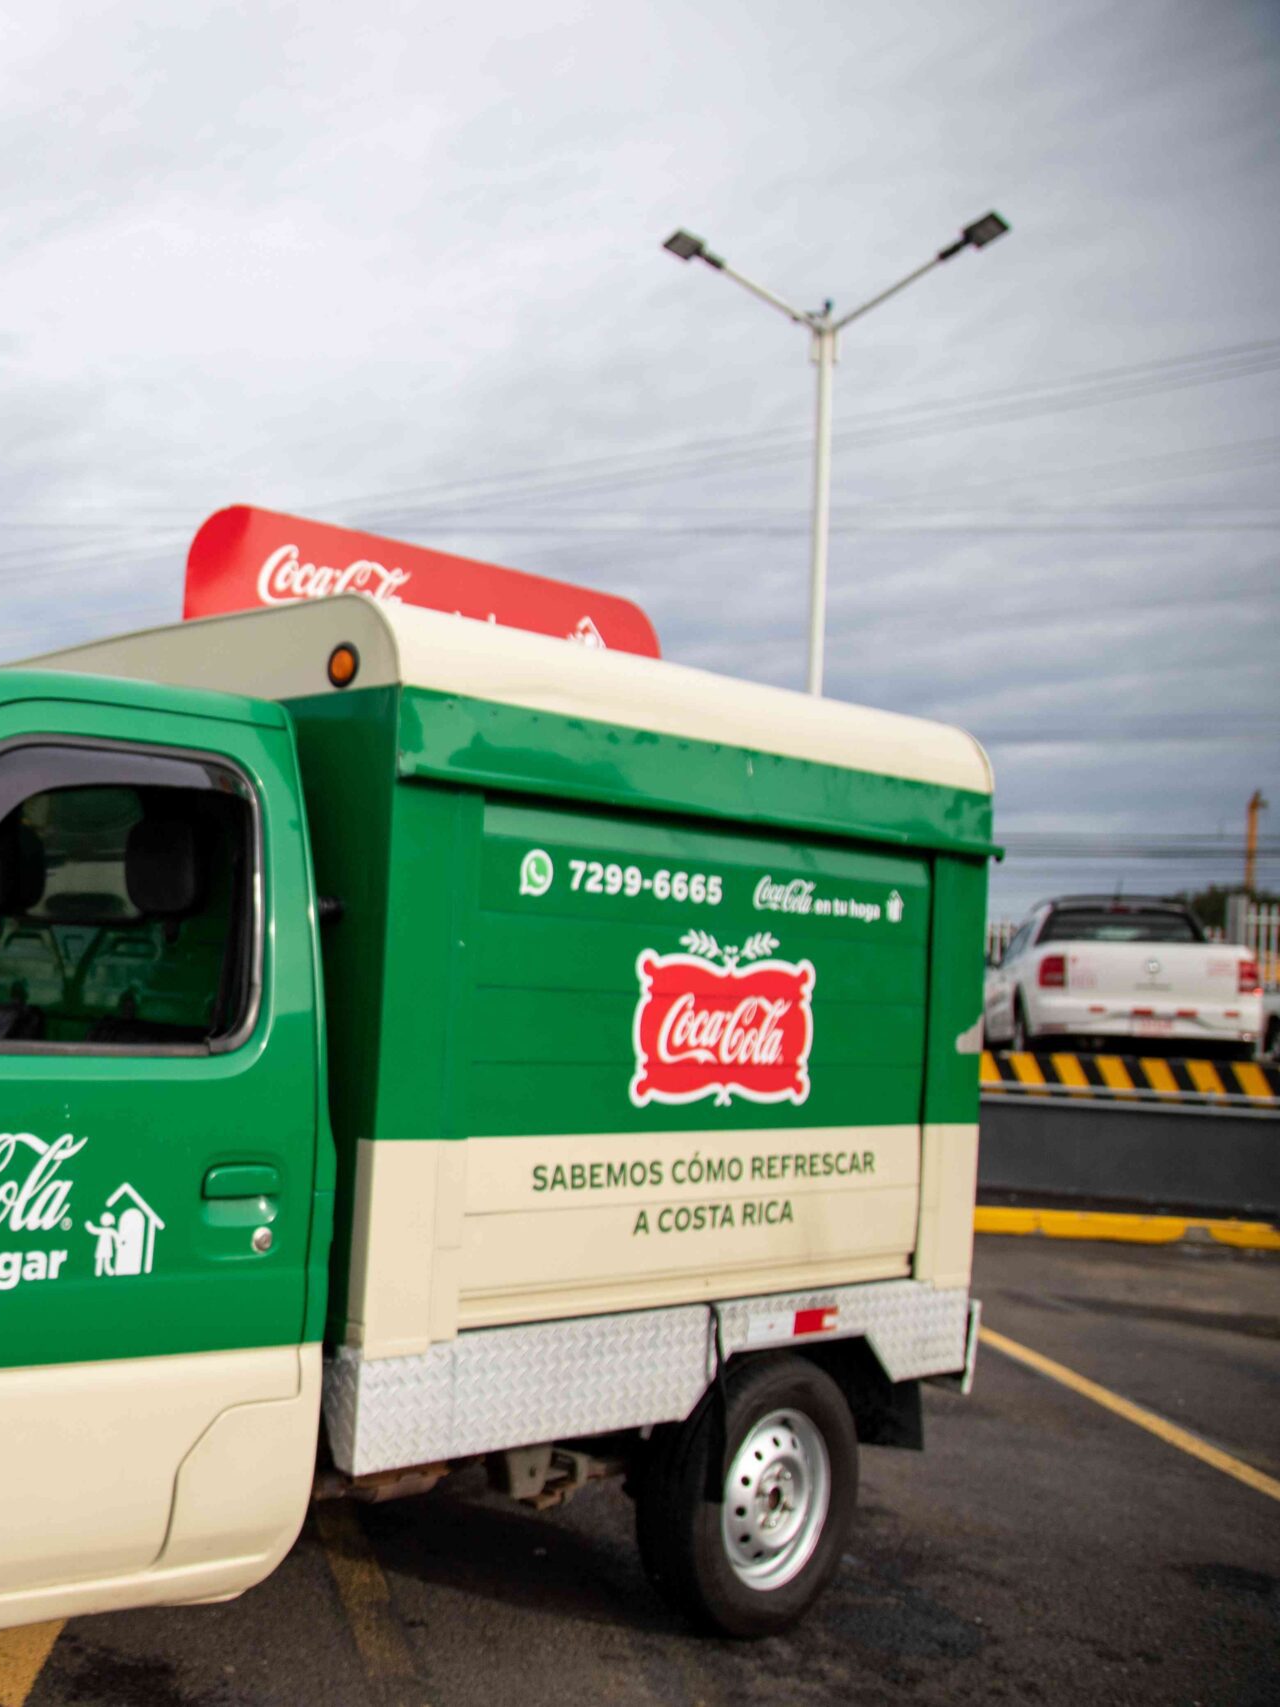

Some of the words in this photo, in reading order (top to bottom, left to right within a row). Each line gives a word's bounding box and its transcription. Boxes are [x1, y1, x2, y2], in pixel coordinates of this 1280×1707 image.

[568, 859, 723, 906] 7299-6665
[753, 874, 816, 914] Coca-Cola
[814, 898, 832, 916] en
[833, 898, 849, 917] tu
[657, 991, 793, 1065] Coca-Cola
[531, 1159, 664, 1193] SABEMOS
[671, 1151, 744, 1185] CÓMO
[750, 1150, 876, 1181] REFRESCAR
[632, 1209, 650, 1236] A
[656, 1204, 736, 1234] COSTA
[741, 1199, 795, 1228] RICA
